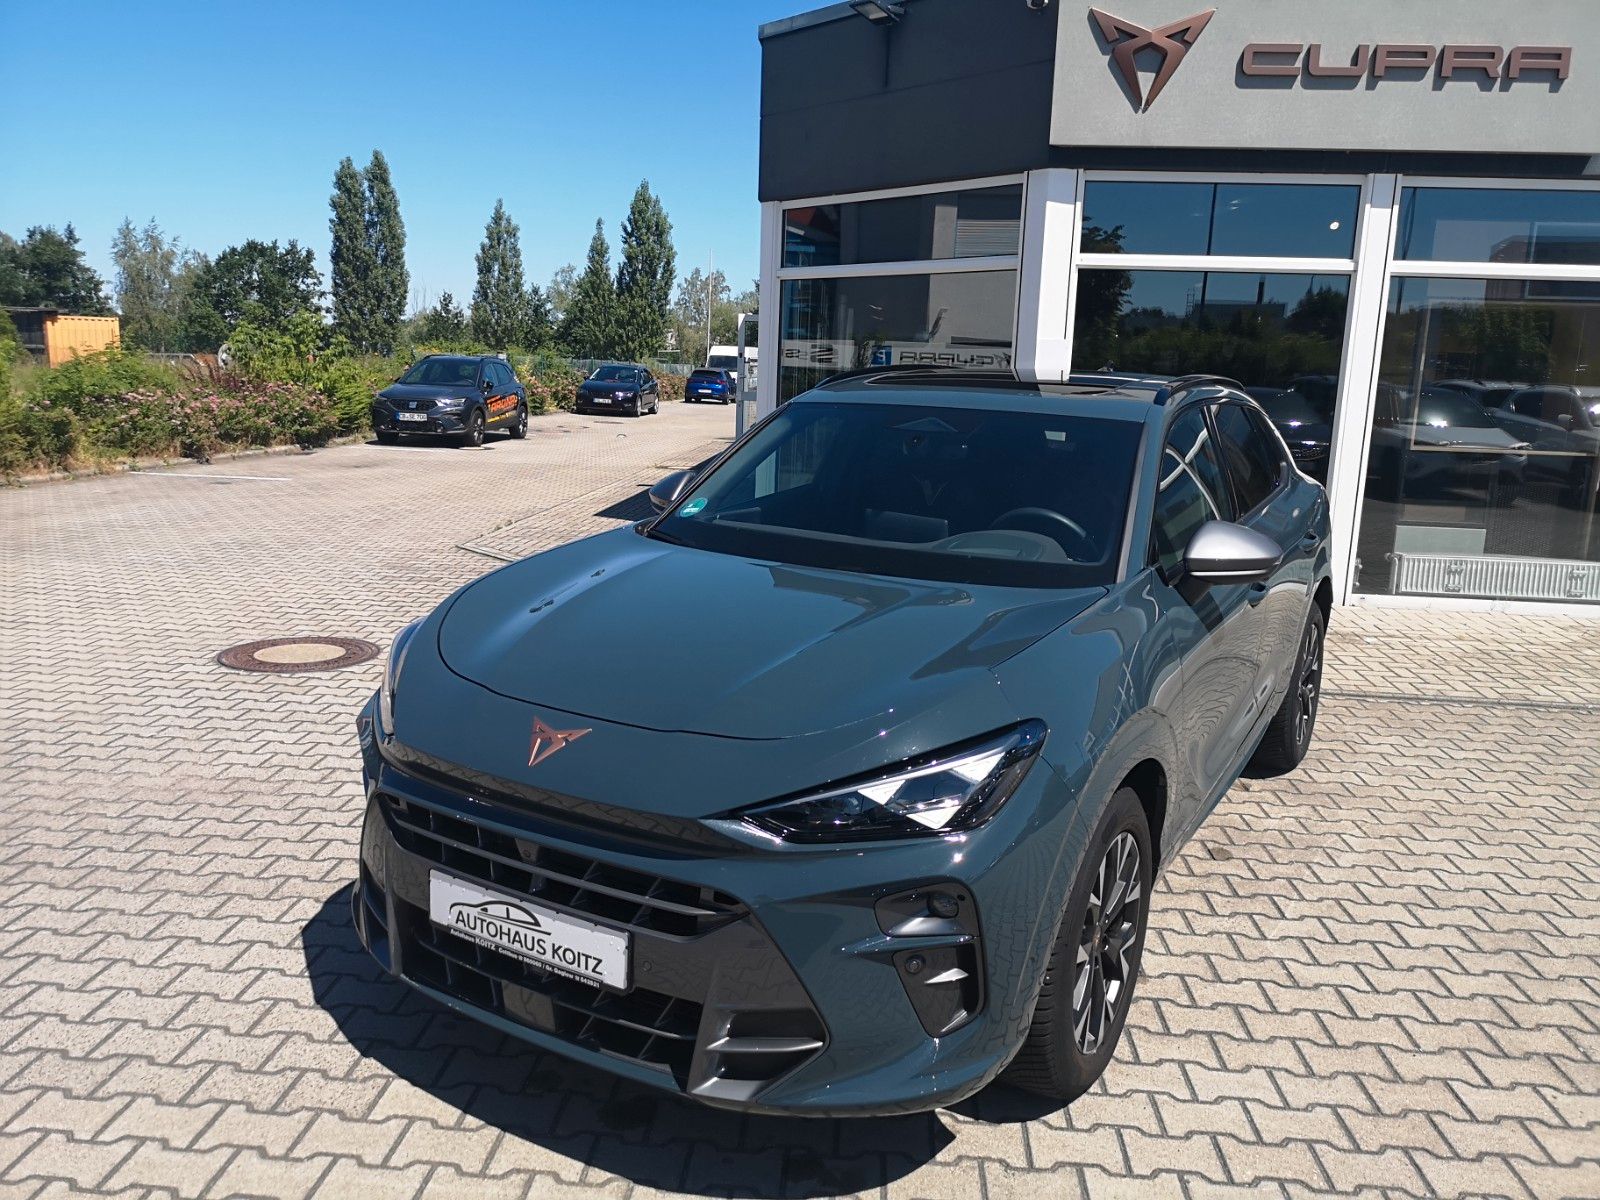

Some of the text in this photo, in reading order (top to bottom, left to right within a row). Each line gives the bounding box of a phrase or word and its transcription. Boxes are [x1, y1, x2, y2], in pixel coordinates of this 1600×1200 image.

[1242, 43, 1573, 80] CUPRA
[455, 909, 604, 976] AUTOHAUS KOITZ
[475, 937, 496, 951] KOITZ
